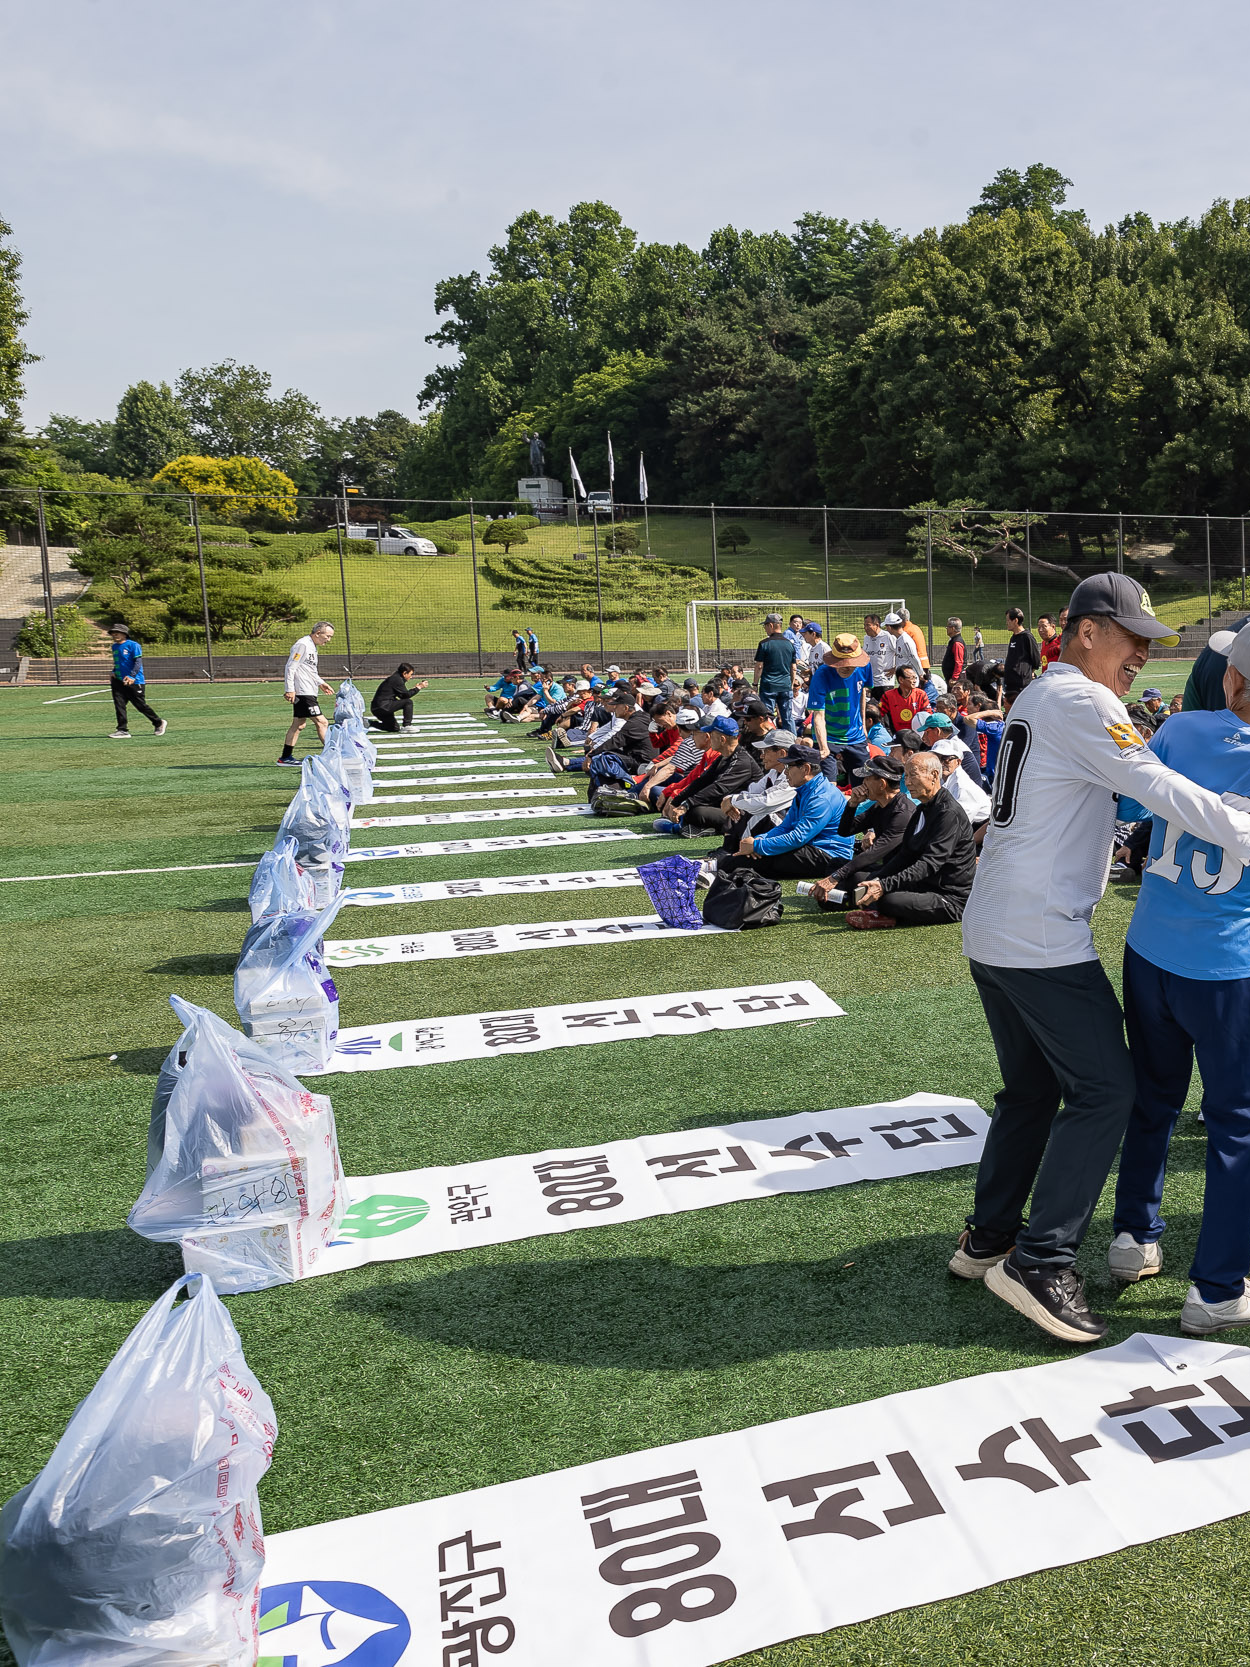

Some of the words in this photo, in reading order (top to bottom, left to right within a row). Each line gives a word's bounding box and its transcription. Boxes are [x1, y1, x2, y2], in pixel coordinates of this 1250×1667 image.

[479, 1013, 541, 1048] 80대
[448, 1184, 491, 1225] 관악구
[533, 1154, 626, 1217] 80대
[580, 1469, 737, 1638] 80대
[439, 1530, 516, 1667] 광진구
